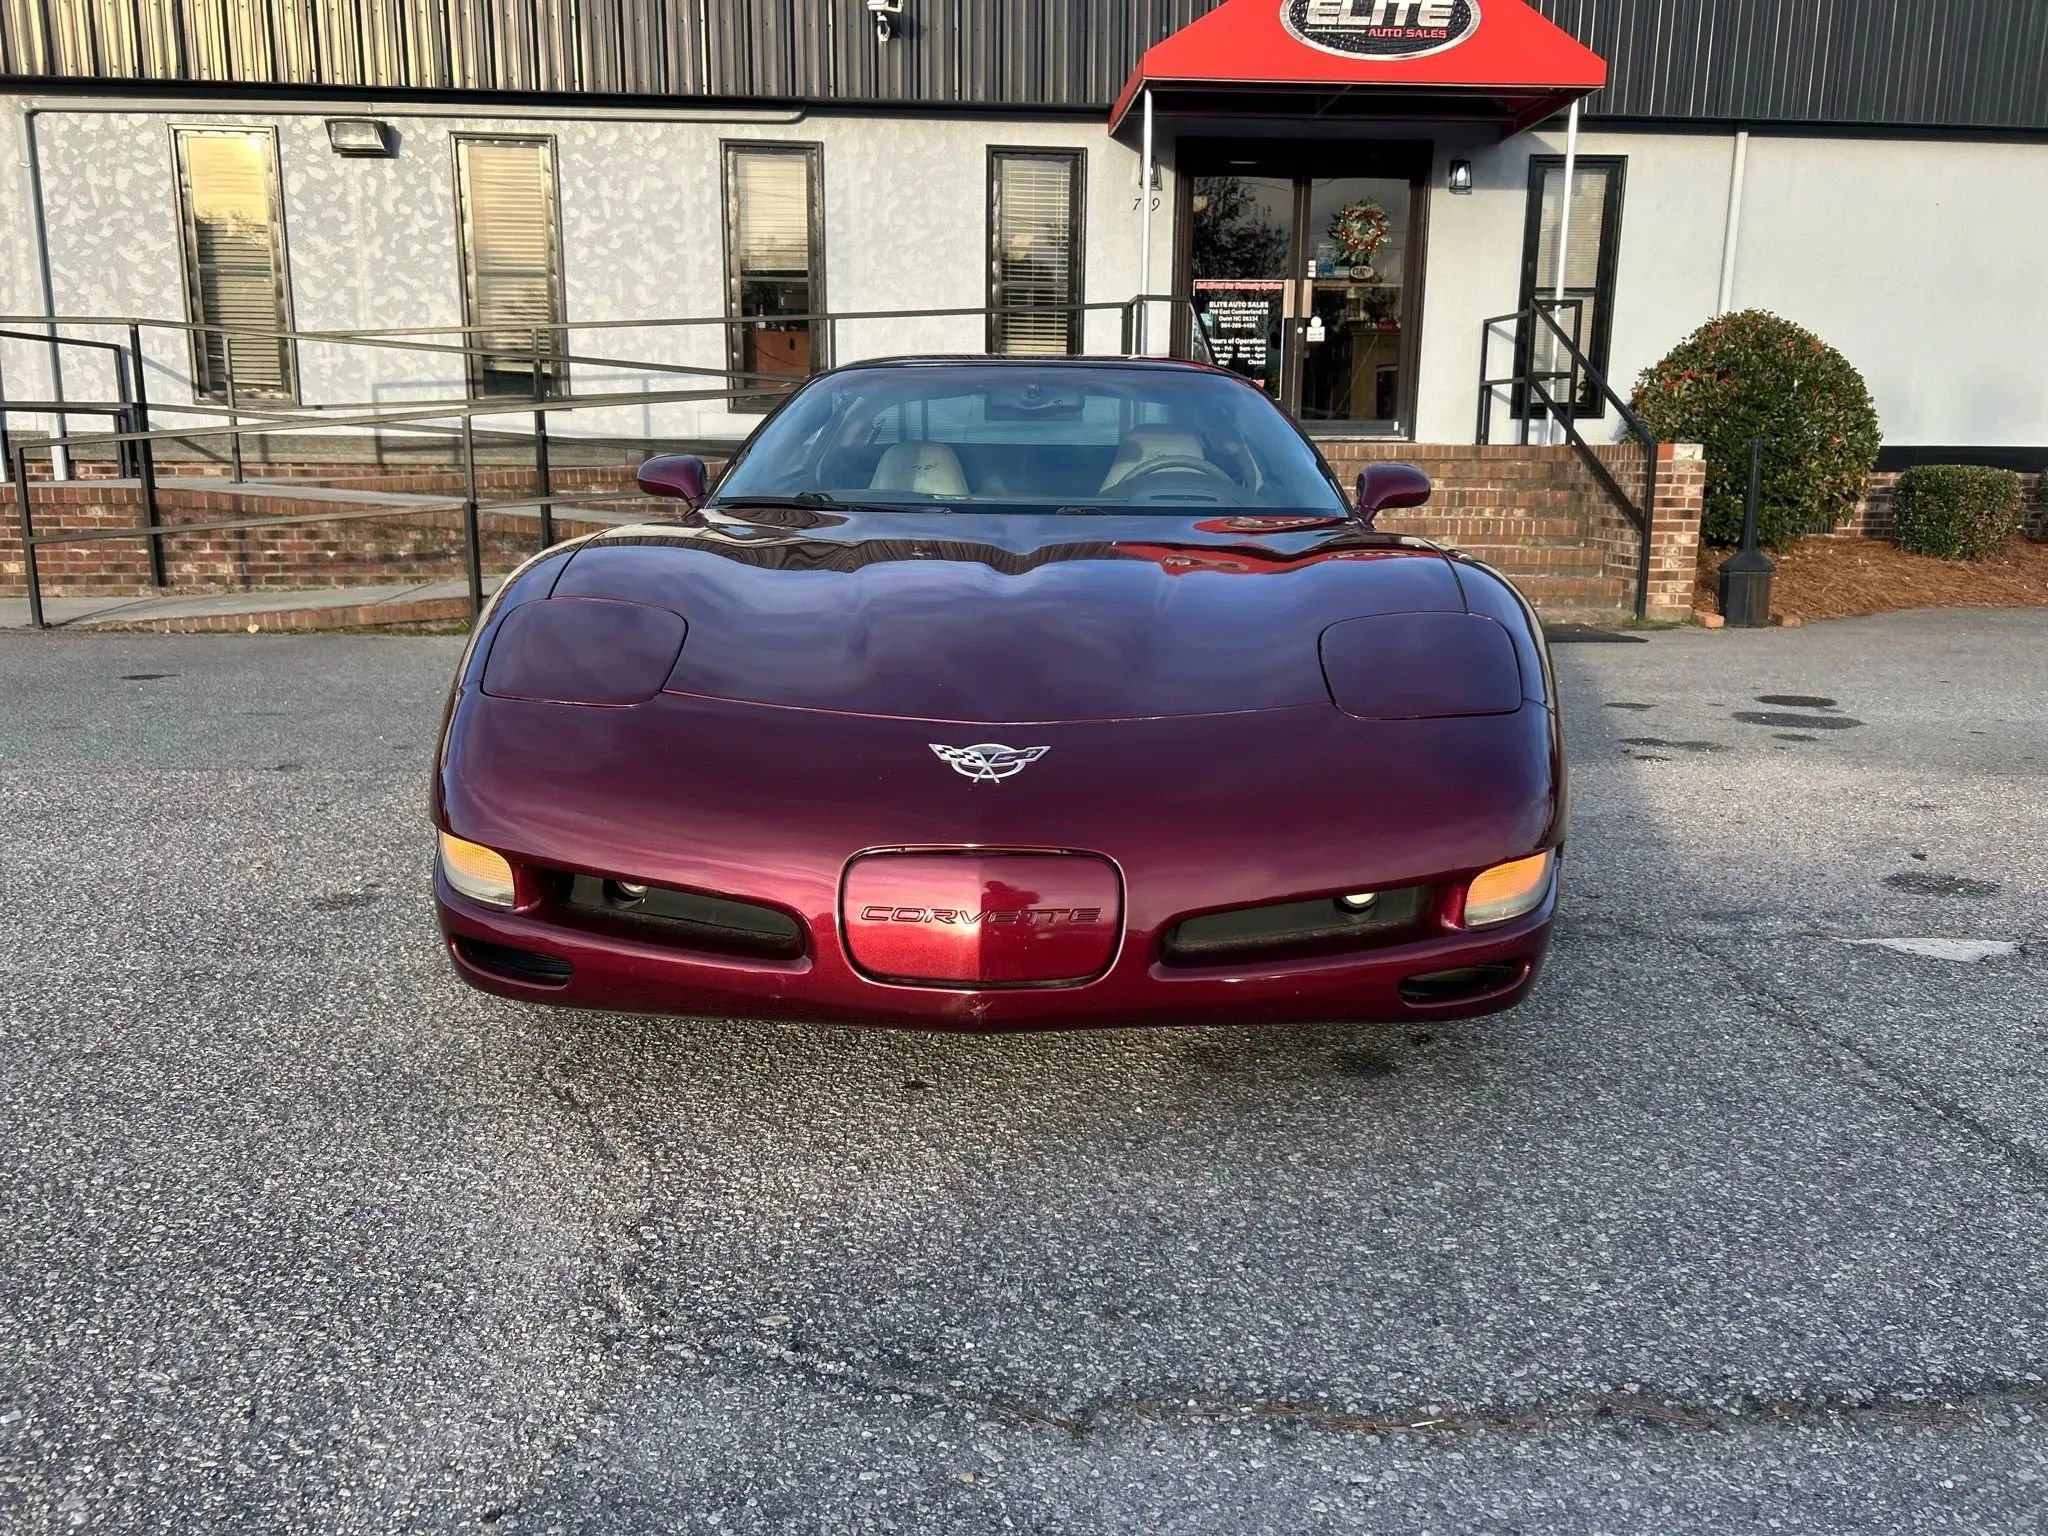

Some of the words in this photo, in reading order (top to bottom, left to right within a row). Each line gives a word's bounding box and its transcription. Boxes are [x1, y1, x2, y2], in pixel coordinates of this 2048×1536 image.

[1306, 0, 1453, 27] ELITE
[1368, 28, 1402, 38] AUTO
[1406, 28, 1448, 39] SALES
[1133, 197, 1161, 211] 79
[1235, 337, 1266, 345] Operation:
[861, 905, 1102, 925] CORVETTE
